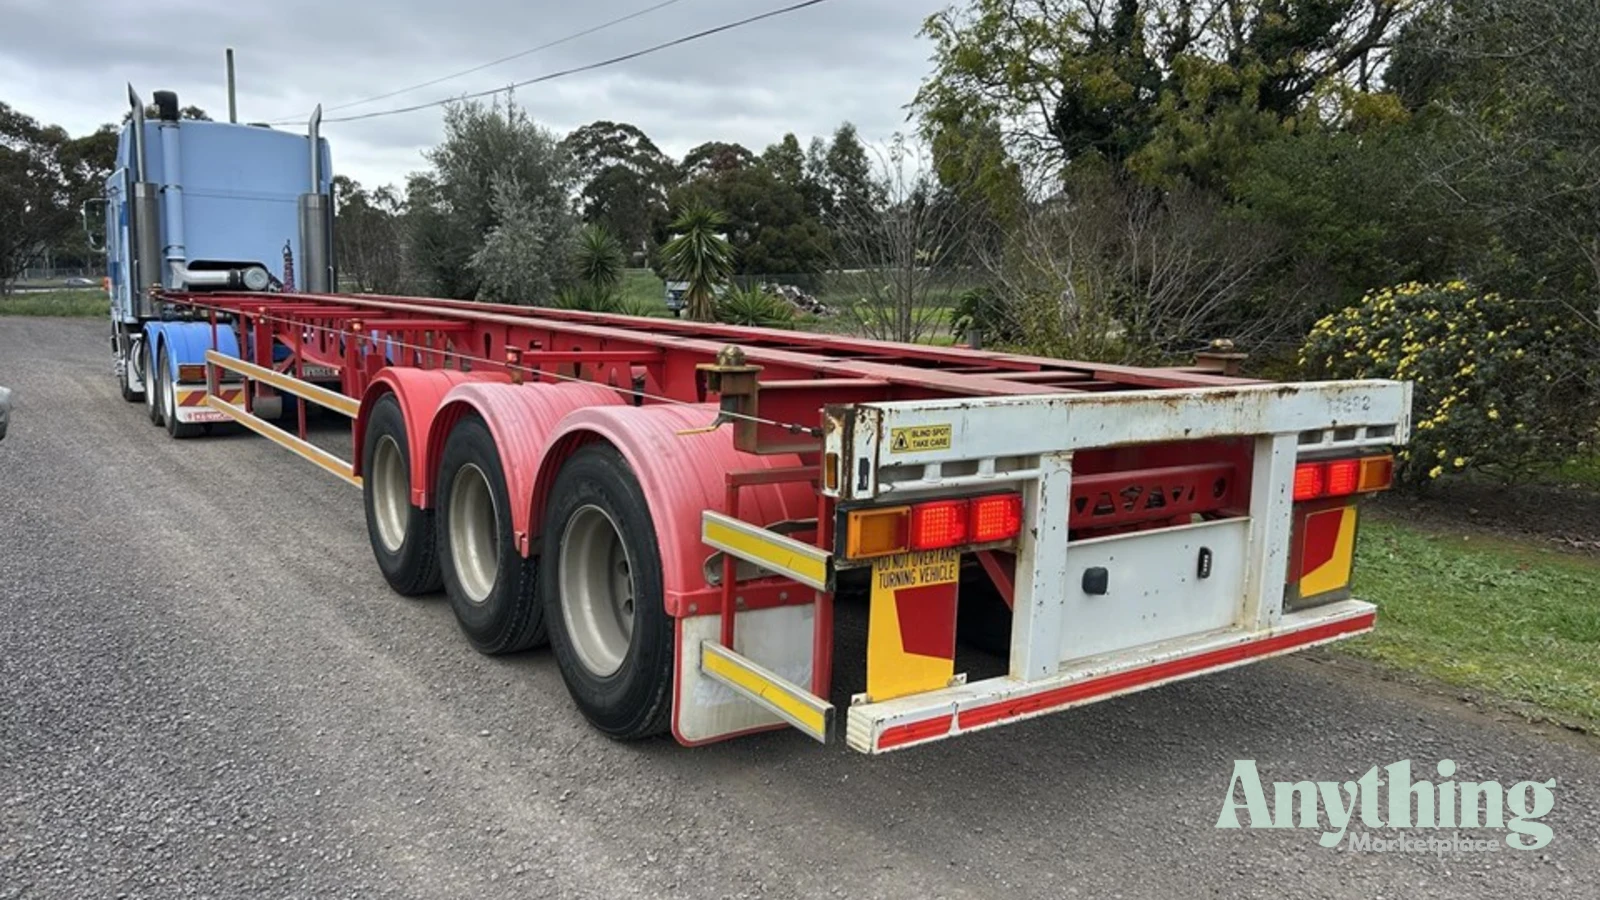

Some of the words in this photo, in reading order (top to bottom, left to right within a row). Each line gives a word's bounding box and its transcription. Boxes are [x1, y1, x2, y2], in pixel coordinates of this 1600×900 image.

[911, 430, 931, 438] BLIND
[932, 427, 949, 436] SPOT
[912, 439, 929, 447] TAKE
[931, 437, 947, 446] CARE
[878, 556, 891, 571] DO
[892, 553, 909, 569] NOT
[879, 568, 916, 589] TURNING
[919, 564, 955, 583] VEHICLE
